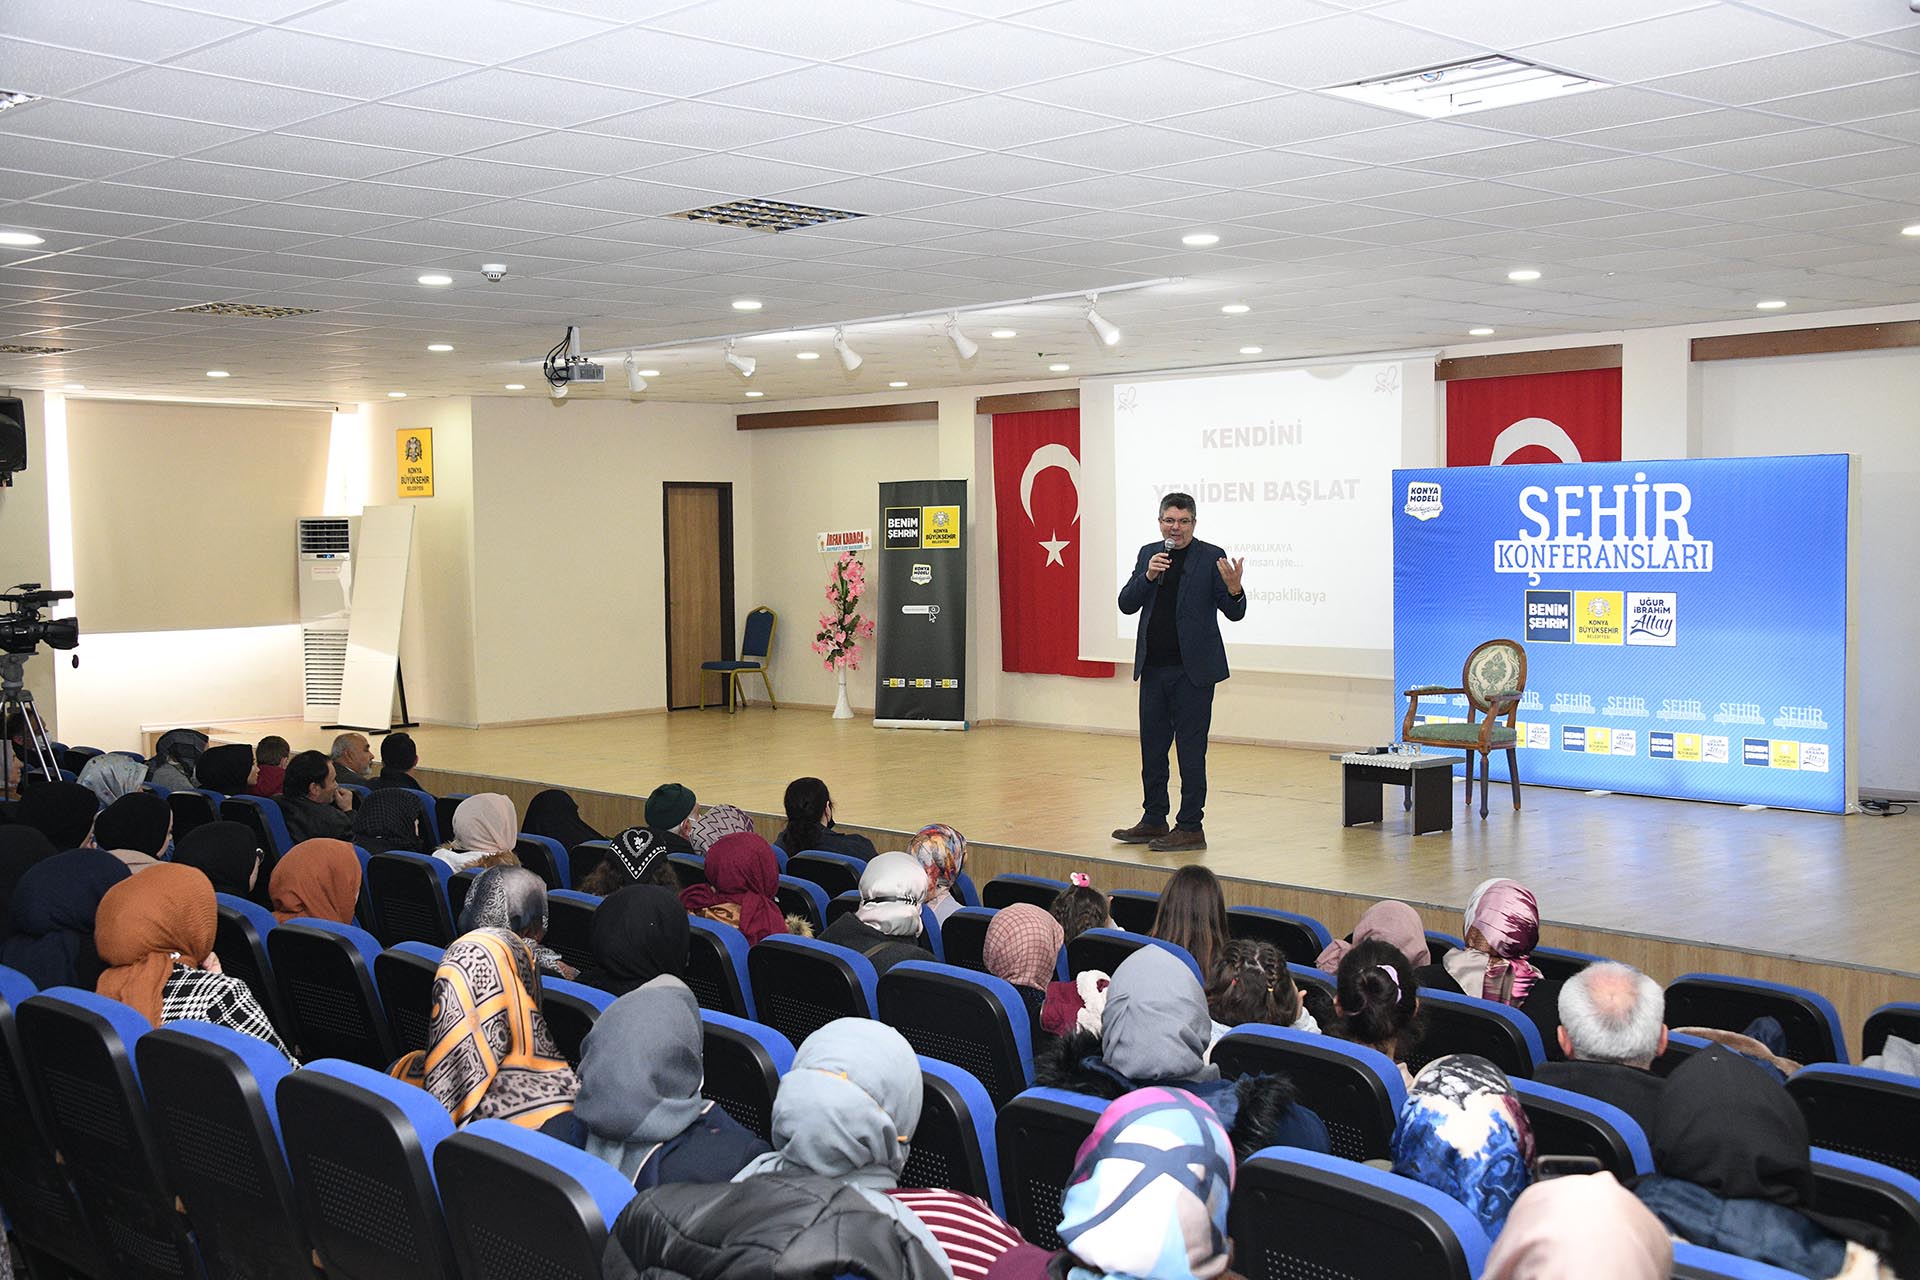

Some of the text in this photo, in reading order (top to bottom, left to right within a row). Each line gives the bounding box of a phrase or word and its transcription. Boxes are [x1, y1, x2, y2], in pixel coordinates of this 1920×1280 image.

[1202, 419, 1303, 449] KENDİNİ
[1263, 479, 1361, 506] BAŞLAT
[888, 518, 918, 528] BENİM
[888, 529, 918, 539] ŞEHRİM
[1498, 544, 1709, 570] KONFERANSLARI
[1247, 588, 1327, 605] akapaklikaya
[1639, 597, 1664, 606] UĞUR
[1528, 603, 1568, 616] BENİM
[1528, 617, 1568, 630] ŞEHRİM
[1630, 614, 1673, 637] Altay
